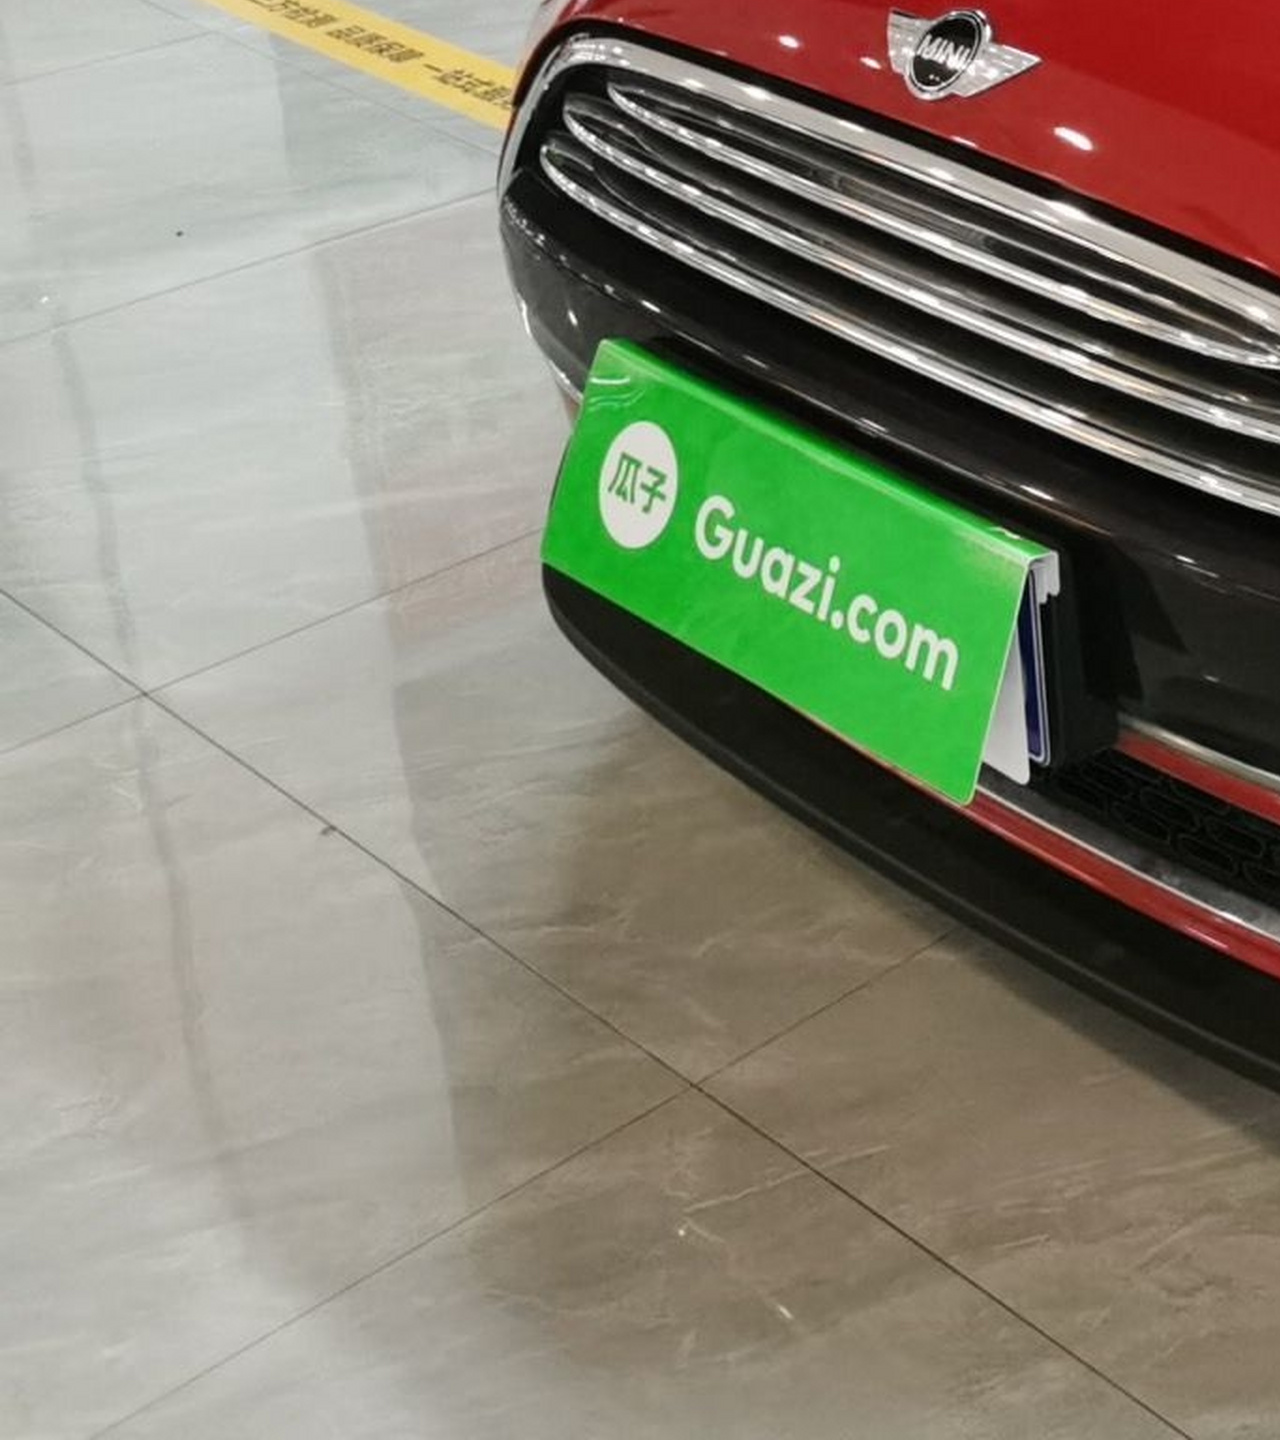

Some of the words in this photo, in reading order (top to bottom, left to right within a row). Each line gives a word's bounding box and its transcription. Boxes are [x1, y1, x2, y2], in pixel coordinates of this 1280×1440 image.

[916, 33, 976, 72] MINI
[607, 452, 667, 514] 瓜子
[695, 494, 959, 691] Guazi.com
